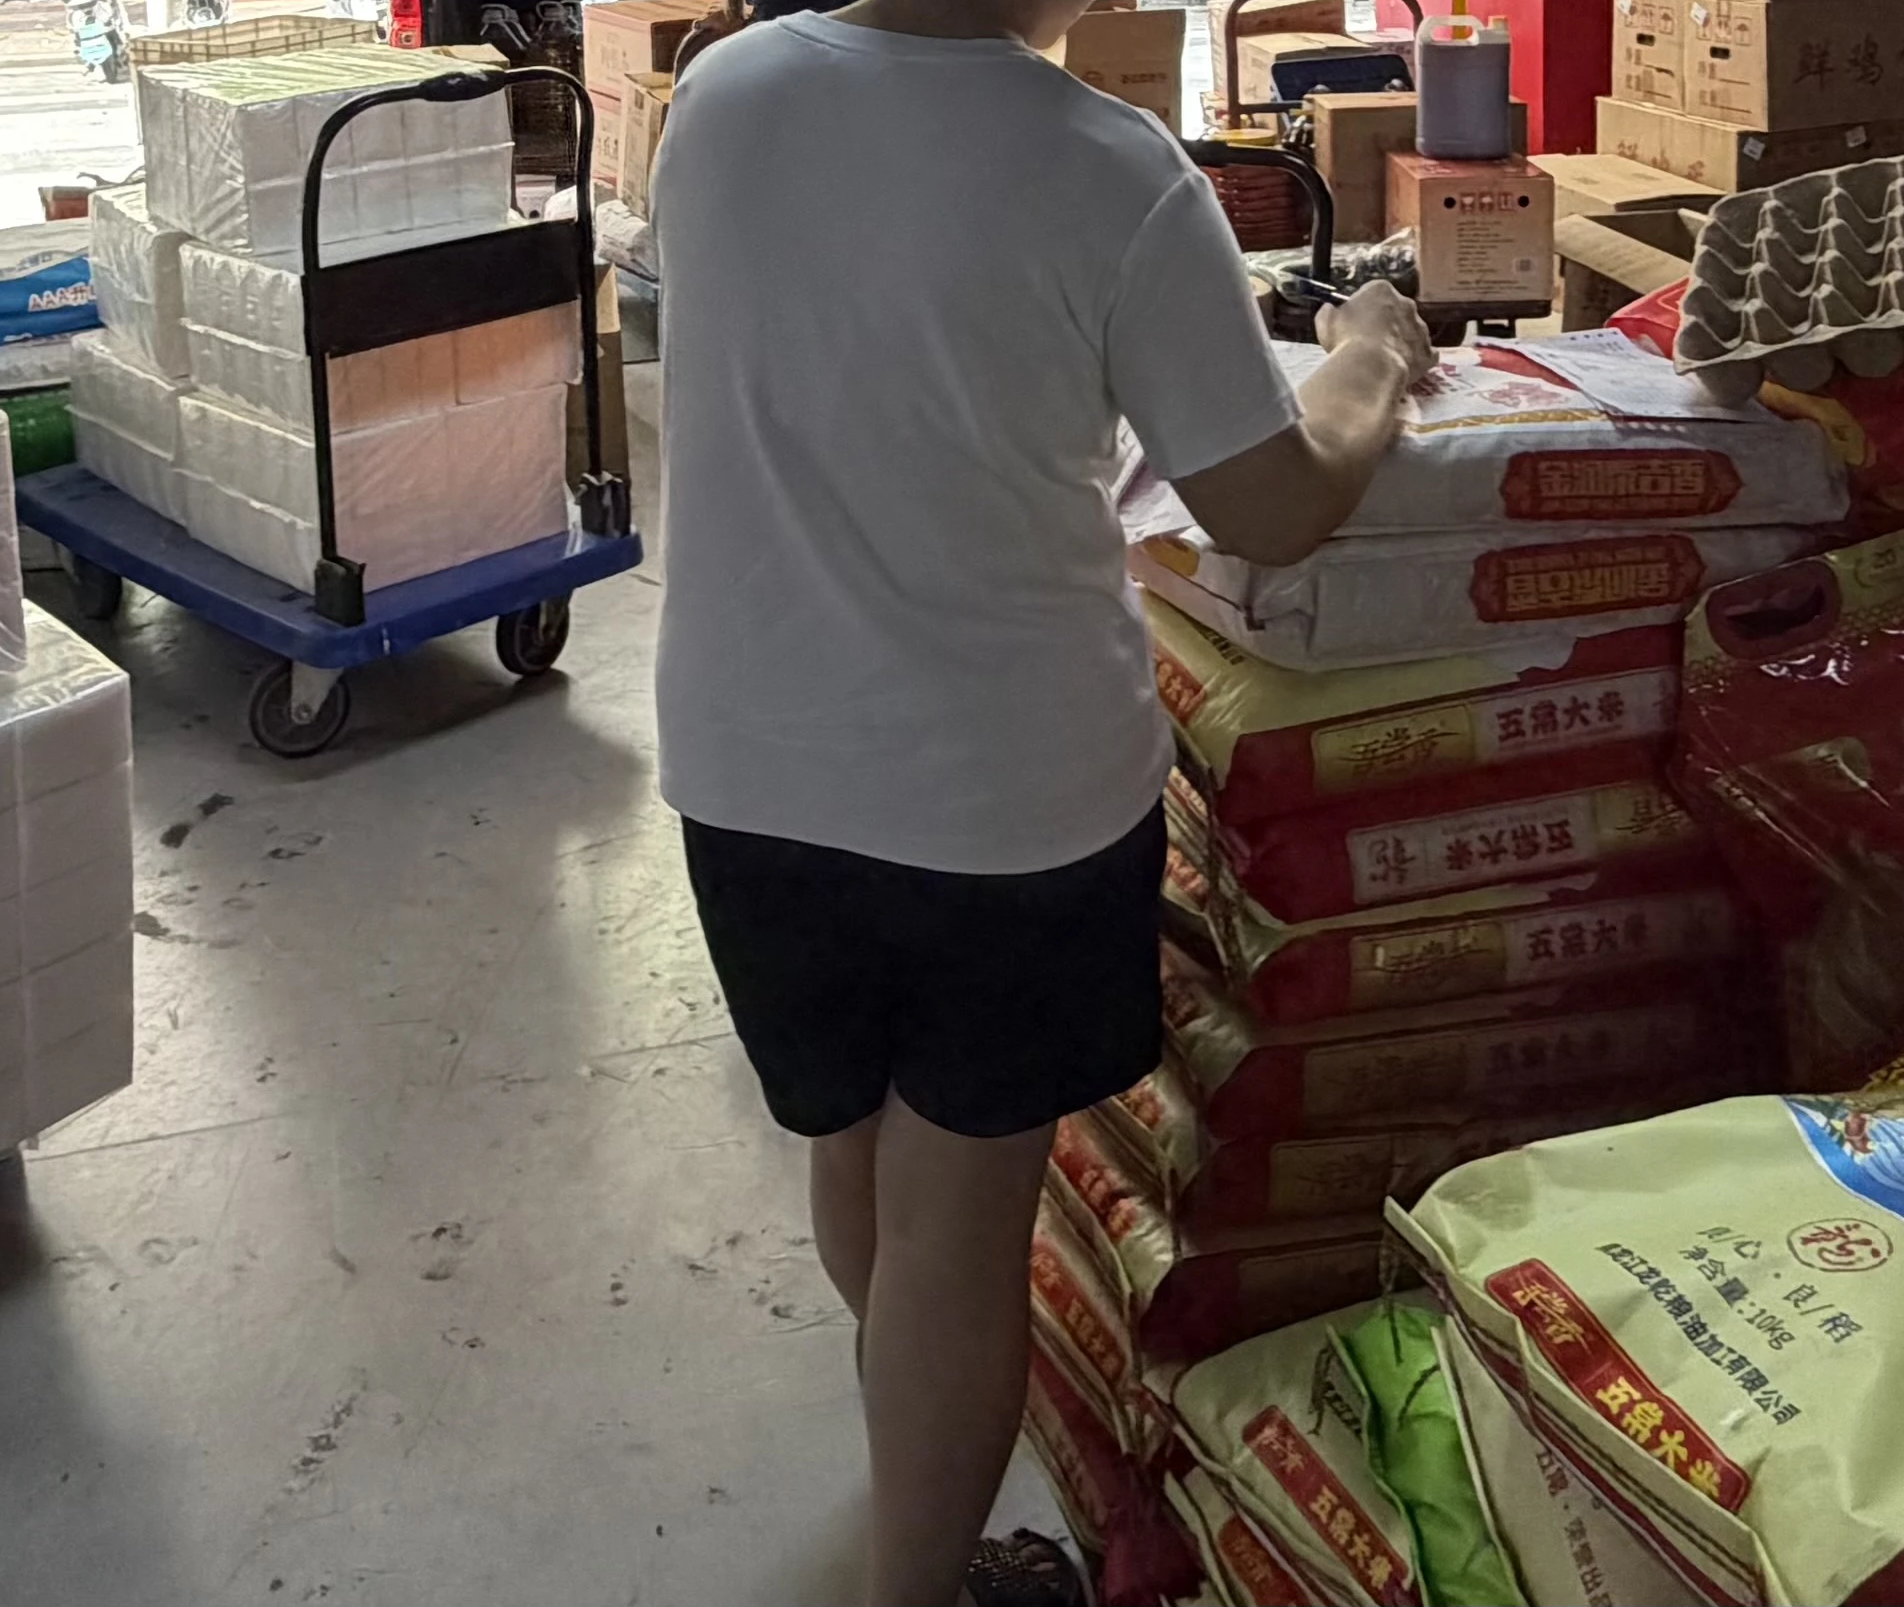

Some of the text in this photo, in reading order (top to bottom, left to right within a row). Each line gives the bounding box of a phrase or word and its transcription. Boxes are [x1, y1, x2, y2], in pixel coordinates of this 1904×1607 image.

[1496, 691, 1625, 742] 五常大米
[1596, 1375, 1723, 1499] 五常大米
